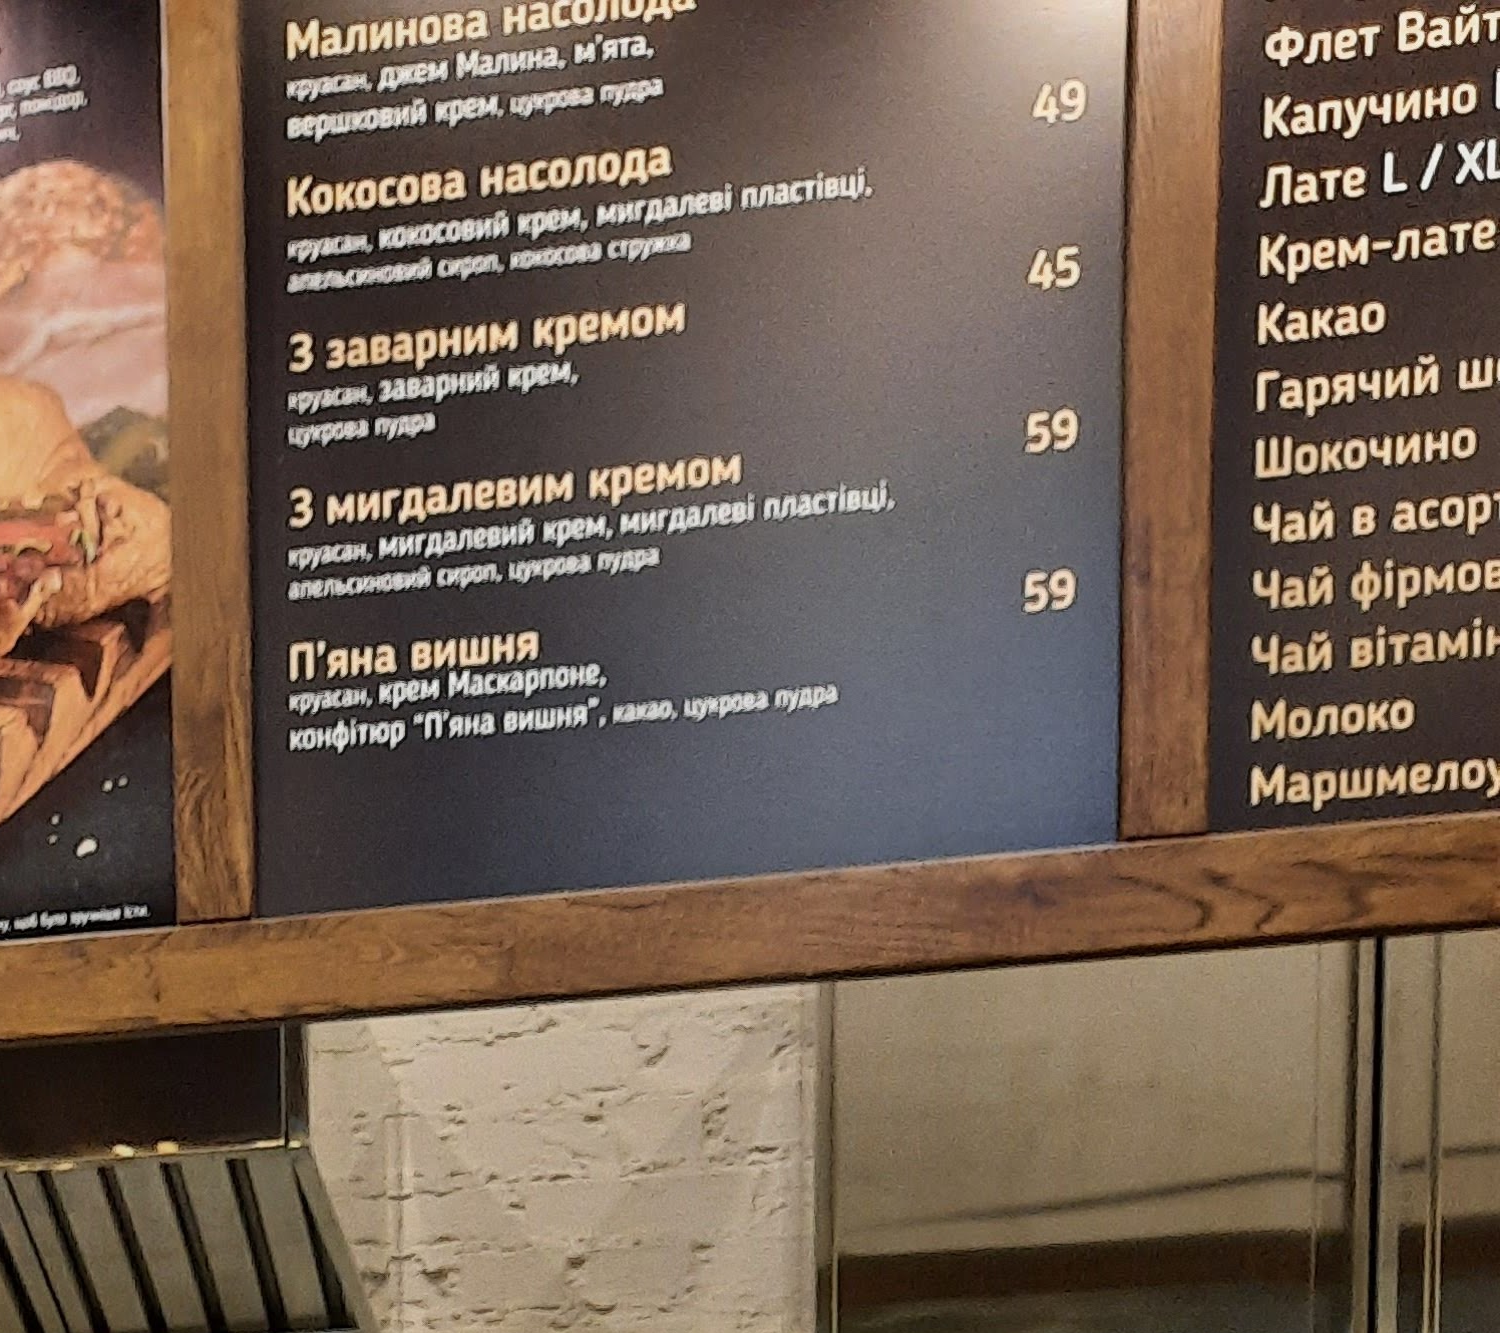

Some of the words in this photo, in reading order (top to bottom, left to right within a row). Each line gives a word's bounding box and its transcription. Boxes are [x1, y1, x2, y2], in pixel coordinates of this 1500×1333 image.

[286, 11, 489, 61] Малинова
[1265, 24, 1381, 68] Флет
[1032, 79, 1086, 124] 49
[1263, 82, 1478, 139] Капучино
[287, 171, 467, 217] Кокосова
[480, 145, 673, 197] насолода
[1259, 164, 1367, 209] Лате
[1027, 245, 1081, 290] 45
[1259, 218, 1496, 284] Крем-лате
[326, 320, 519, 371] заварним
[533, 302, 686, 355] кремом
[1257, 301, 1386, 345] Какао
[1256, 353, 1440, 418] Гарячий
[1025, 409, 1078, 453] 59
[1255, 427, 1477, 478] Шокочино
[326, 471, 575, 529] мигдалевим
[589, 454, 742, 507] кремом
[378, 517, 535, 559] мигдалевий
[1253, 499, 1335, 543] Чай
[1024, 568, 1076, 613] 59
[1252, 565, 1334, 609] Чай
[411, 630, 539, 672] вишня
[1251, 630, 1333, 675] Чай
[289, 718, 406, 754] конфітюр
[1251, 698, 1415, 741] Молоко
